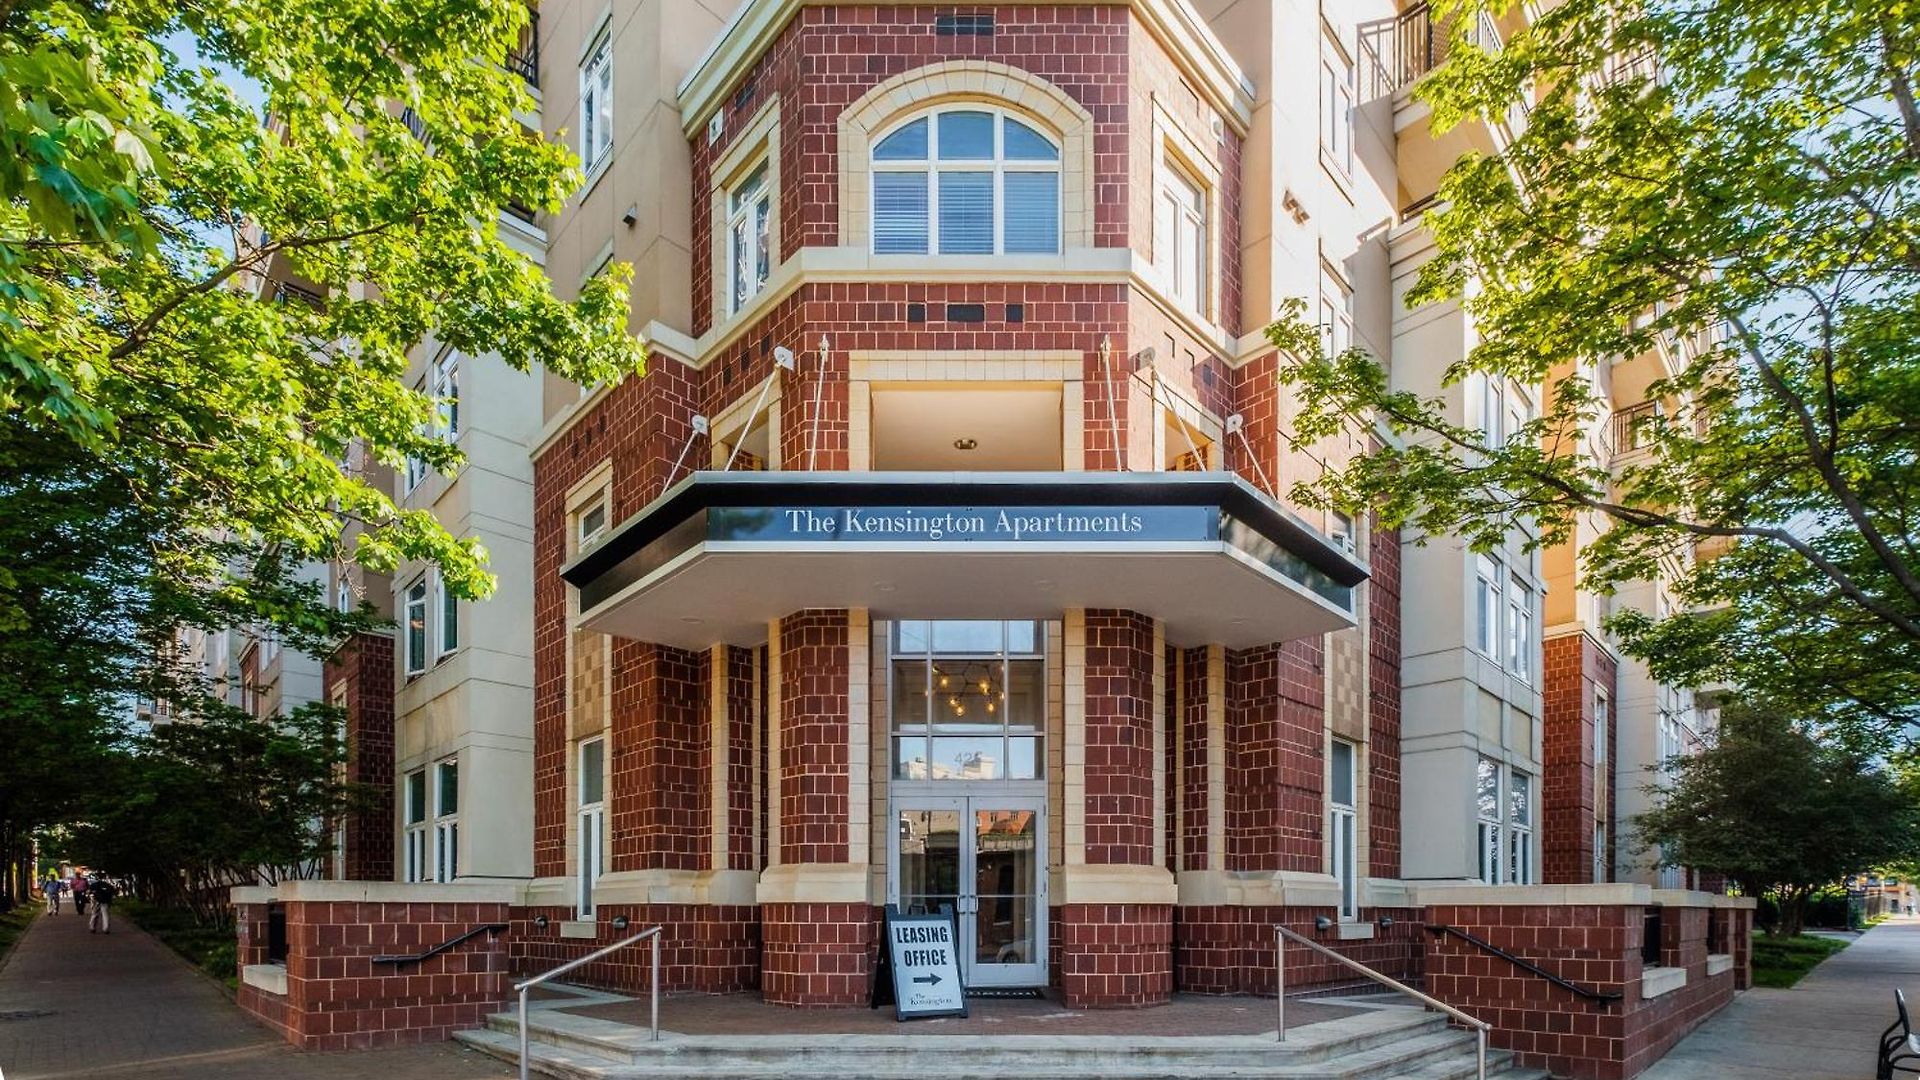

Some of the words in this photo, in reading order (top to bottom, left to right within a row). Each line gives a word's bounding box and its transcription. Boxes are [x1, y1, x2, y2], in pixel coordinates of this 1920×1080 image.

[785, 510, 836, 533] The
[845, 510, 985, 540] Kensington
[994, 510, 1143, 540] Apartments
[896, 926, 949, 943] LEASING
[904, 949, 947, 967] OFFICE
